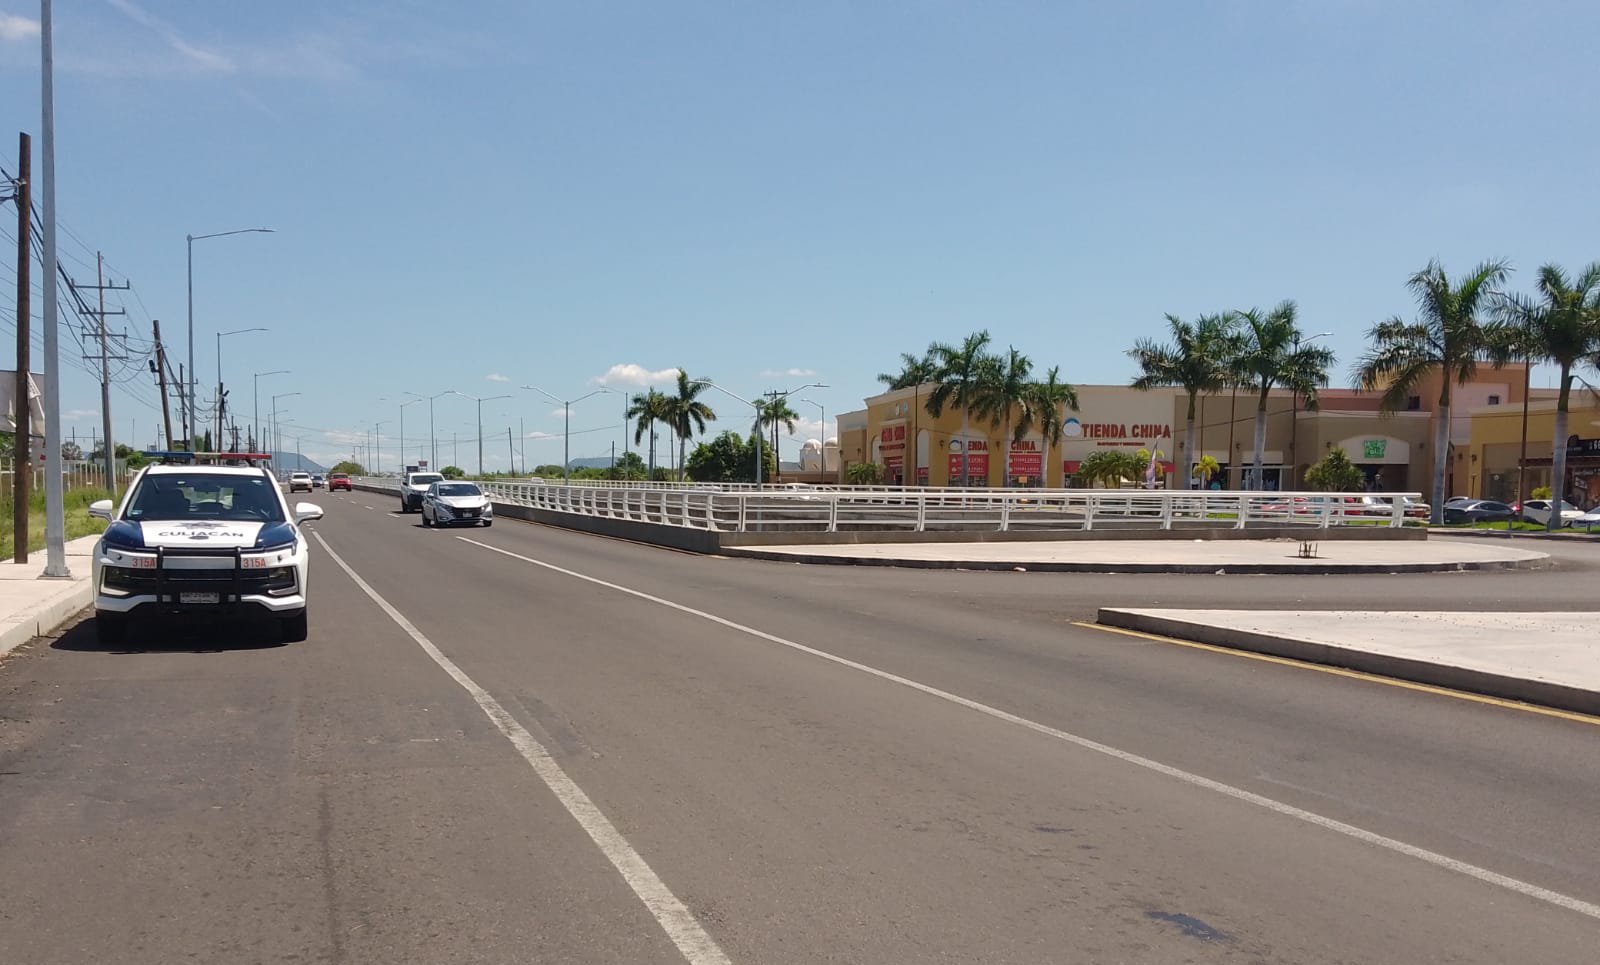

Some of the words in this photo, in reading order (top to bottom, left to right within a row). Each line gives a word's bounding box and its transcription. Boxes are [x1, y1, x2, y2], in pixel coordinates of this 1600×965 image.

[1081, 423, 1127, 438] TIENDA
[1132, 423, 1171, 439] CHINA
[132, 558, 156, 568] 315A
[243, 558, 266, 568] 315A
